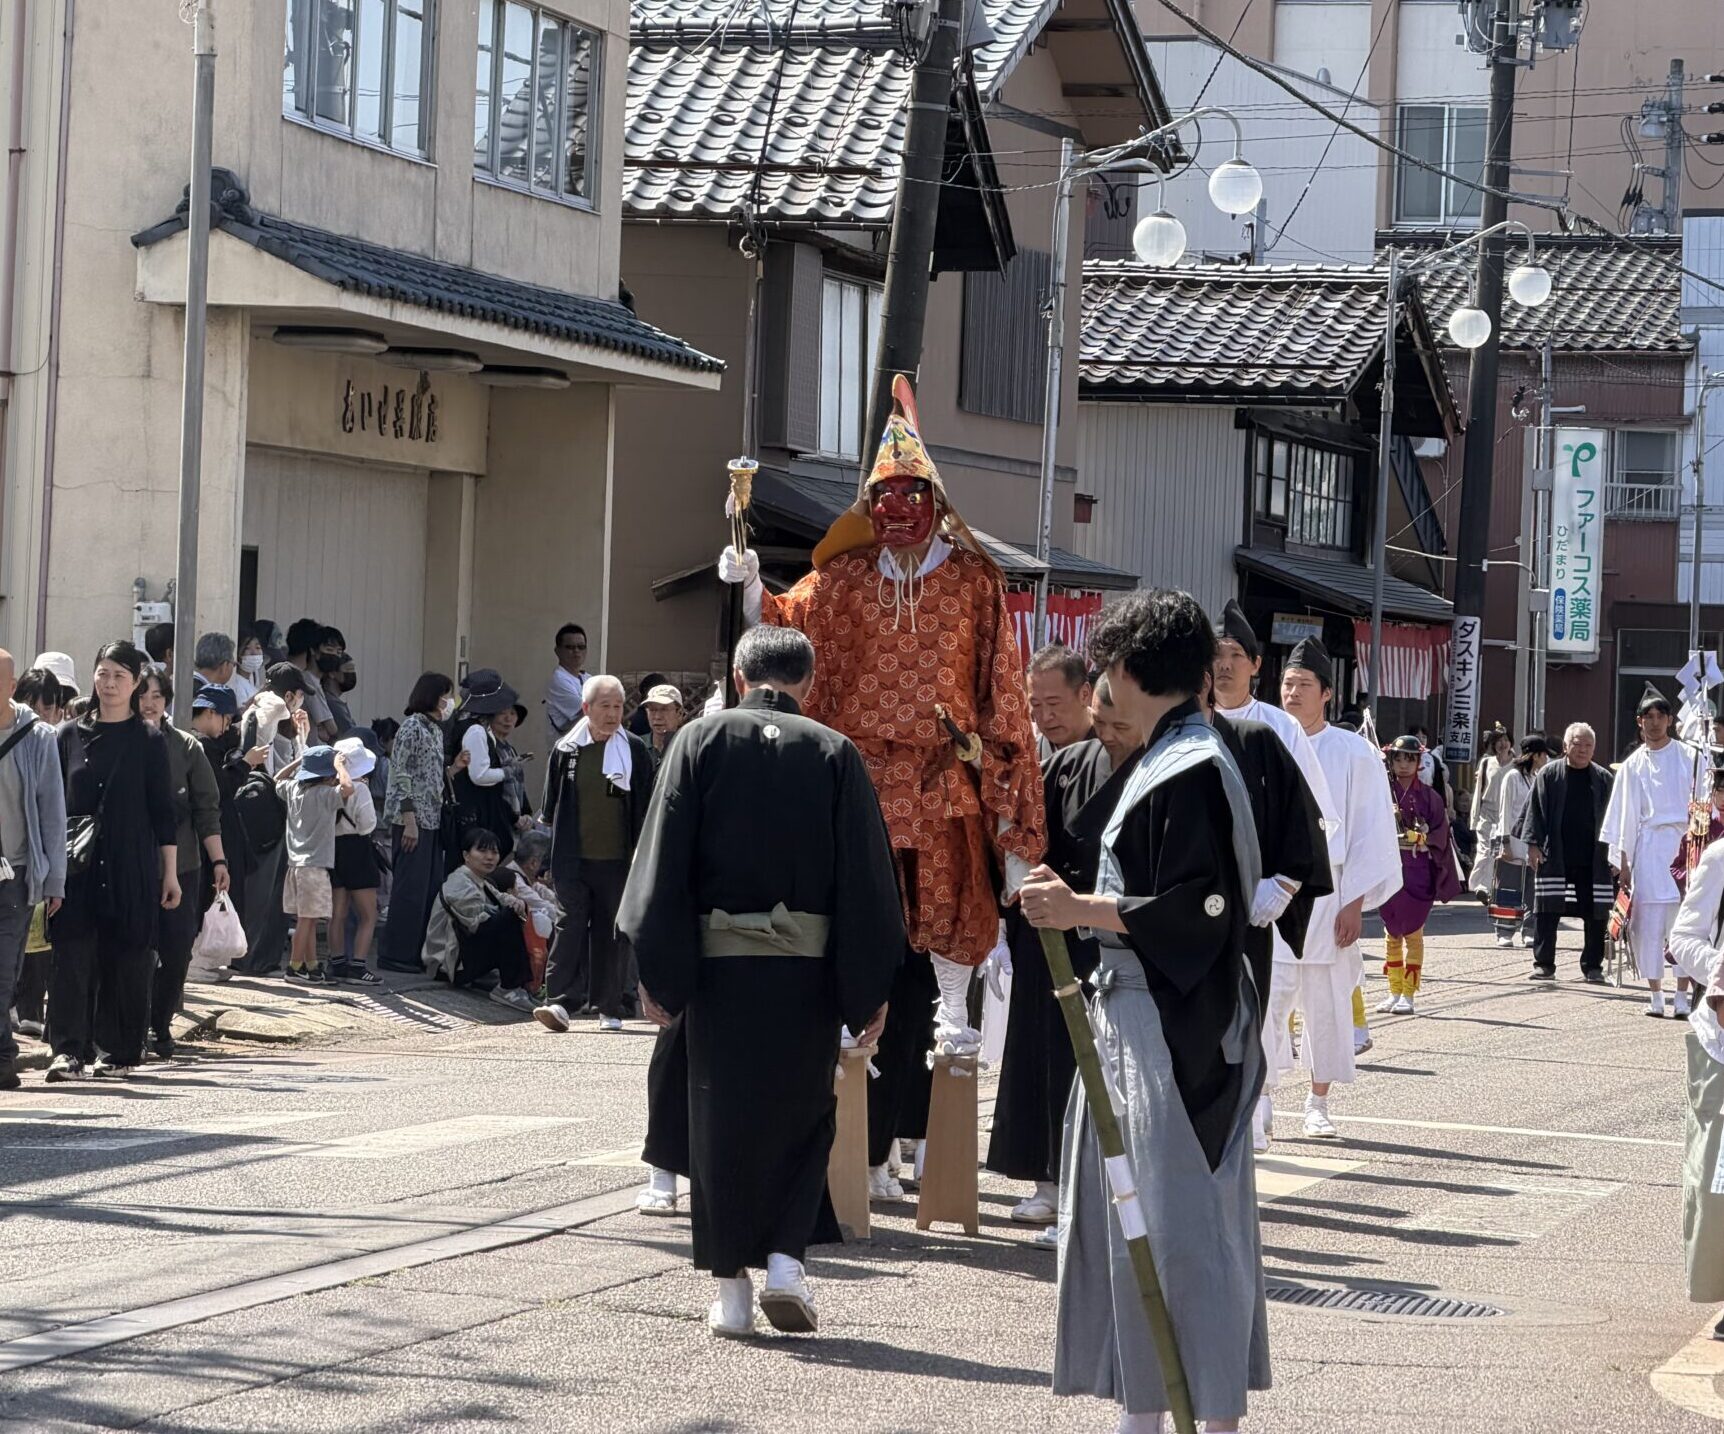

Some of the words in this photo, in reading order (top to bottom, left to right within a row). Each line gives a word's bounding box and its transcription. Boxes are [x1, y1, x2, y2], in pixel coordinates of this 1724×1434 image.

[1556, 525, 1568, 579] ひだまり
[1569, 489, 1595, 641] ファーコス薬局
